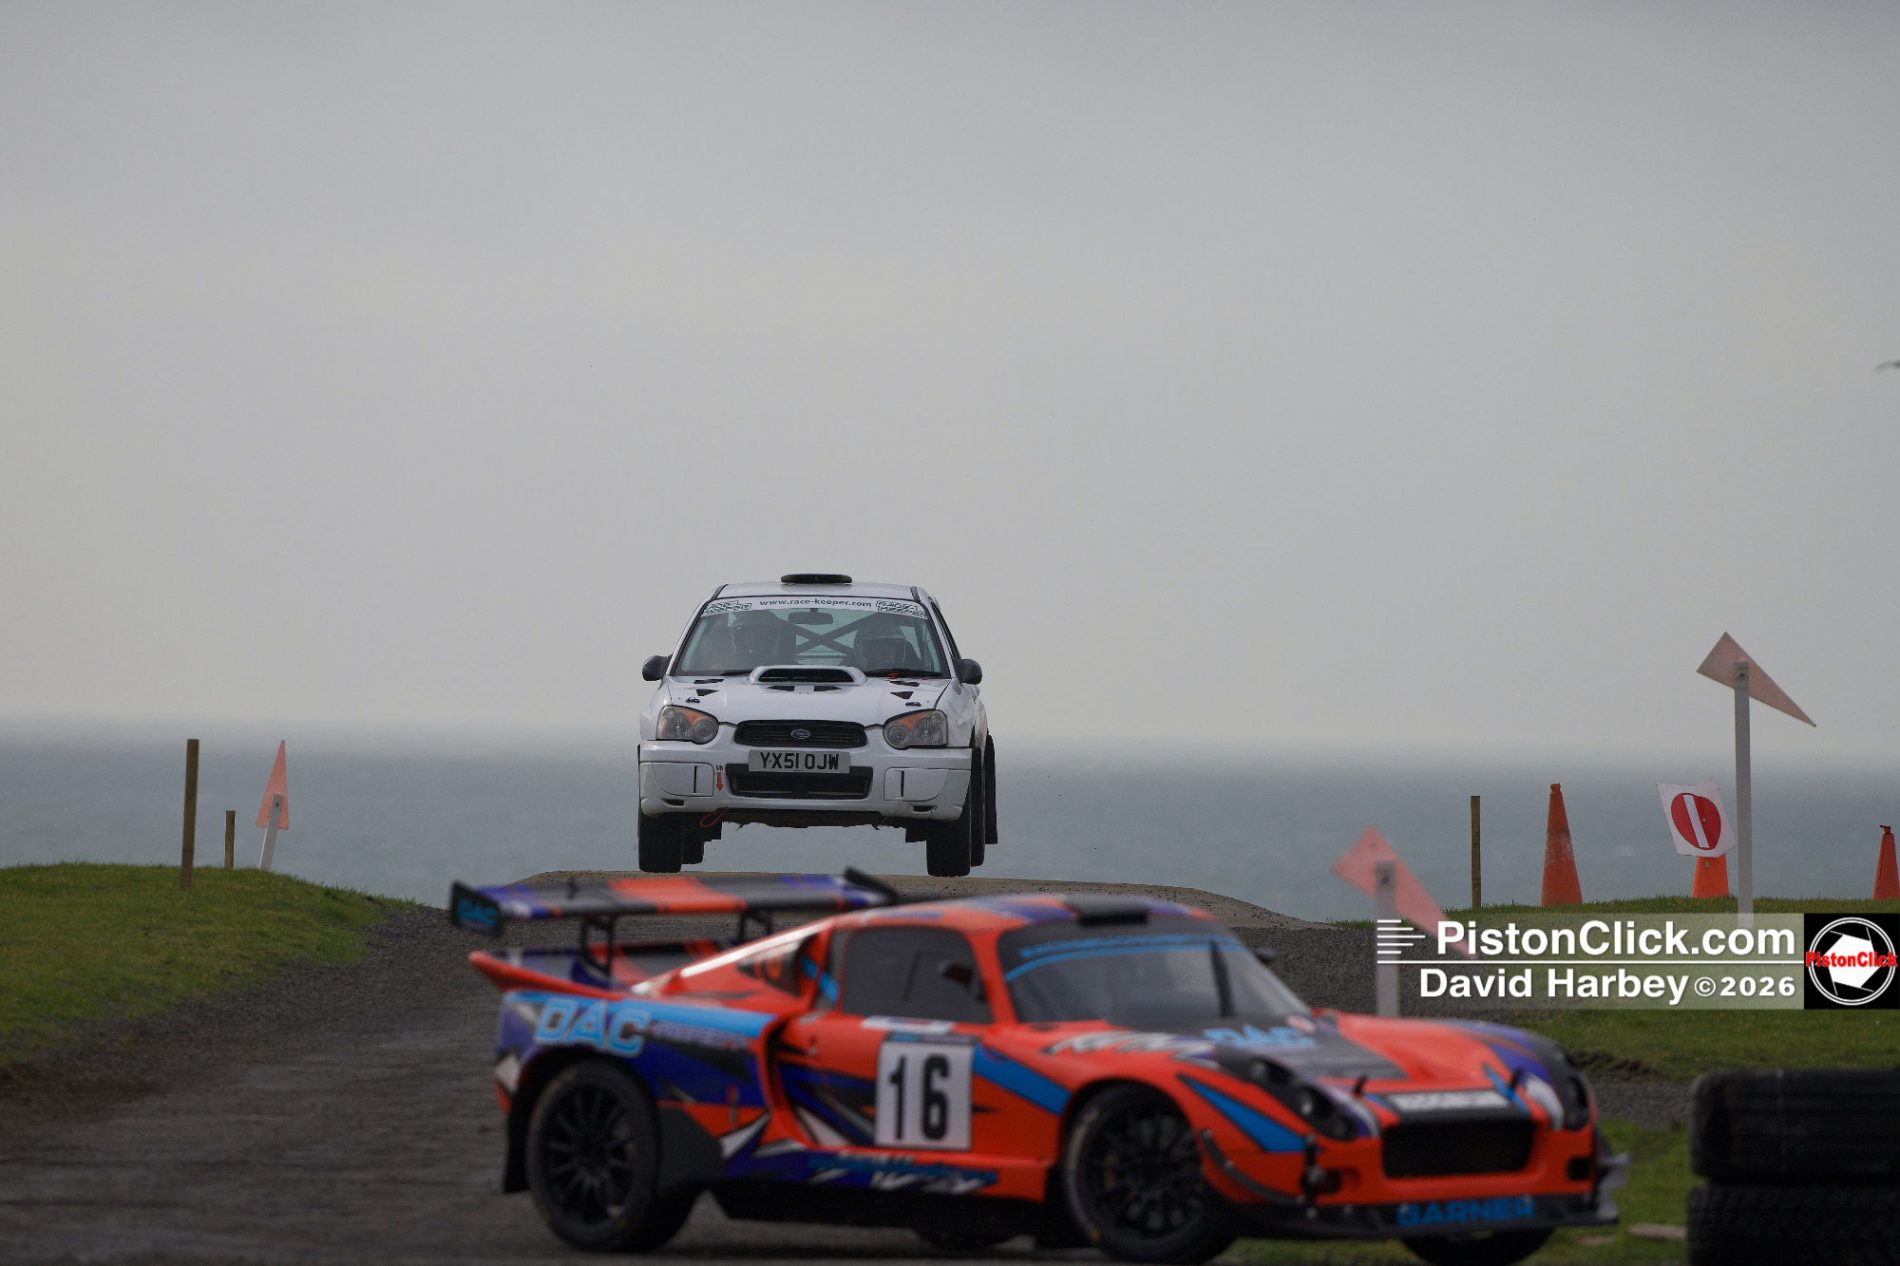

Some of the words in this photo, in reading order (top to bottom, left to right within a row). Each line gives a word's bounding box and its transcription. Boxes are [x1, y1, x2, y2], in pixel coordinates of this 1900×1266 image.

[760, 598, 872, 608] www.race-keeper.com
[760, 752, 799, 769] YX51
[804, 753, 839, 770] OJW
[534, 999, 650, 1058] DAC
[889, 1053, 949, 1141] 16
